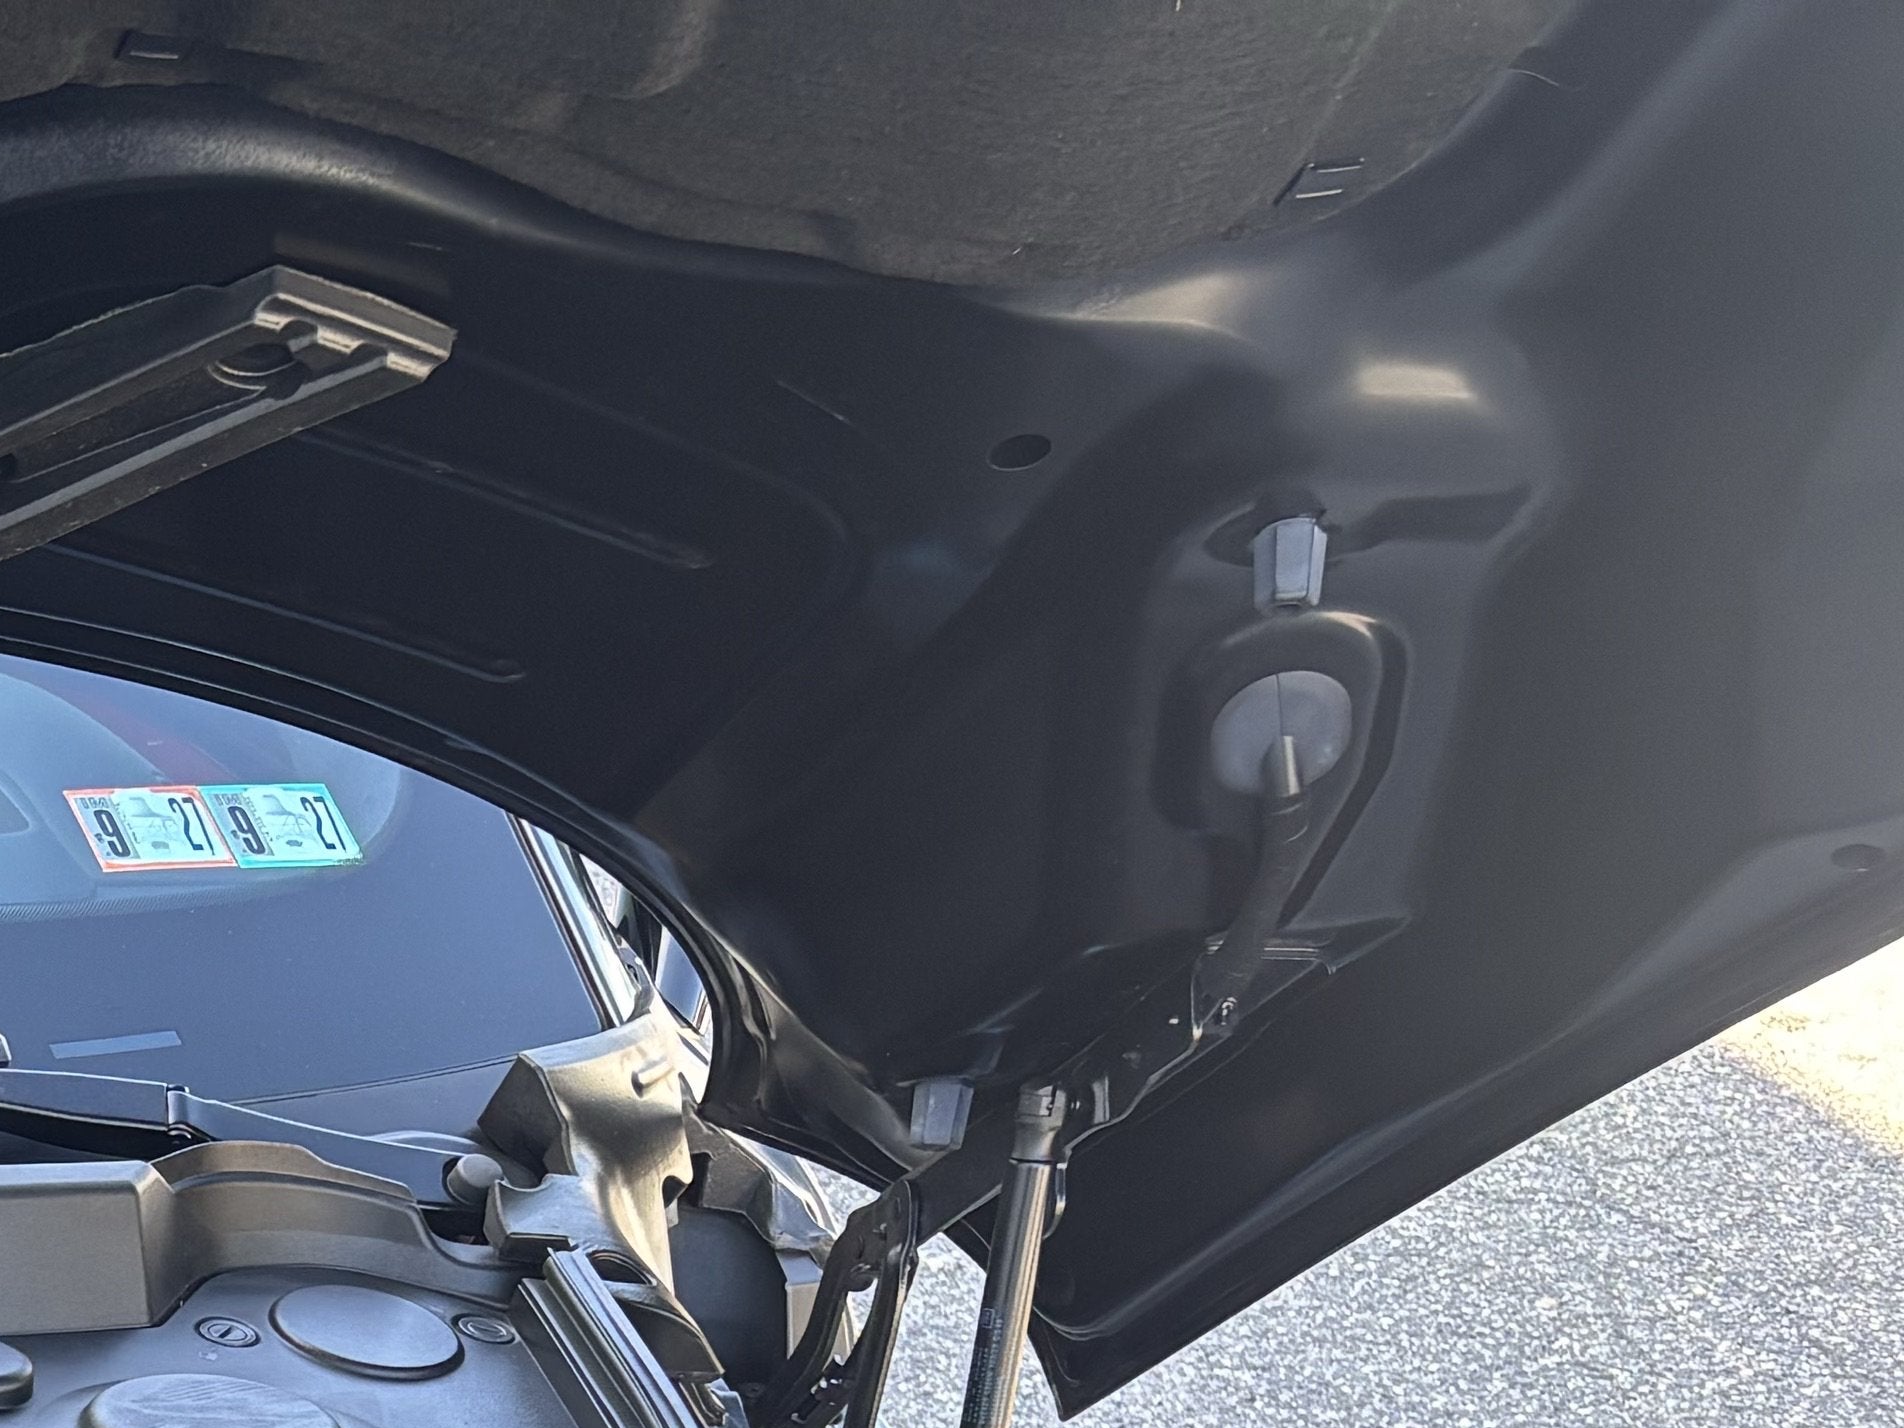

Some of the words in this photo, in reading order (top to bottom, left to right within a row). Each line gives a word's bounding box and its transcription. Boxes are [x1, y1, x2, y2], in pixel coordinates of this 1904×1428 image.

[93, 809, 131, 858] 9
[167, 796, 216, 856] 27
[226, 805, 266, 855] 9
[300, 796, 347, 853] 27
